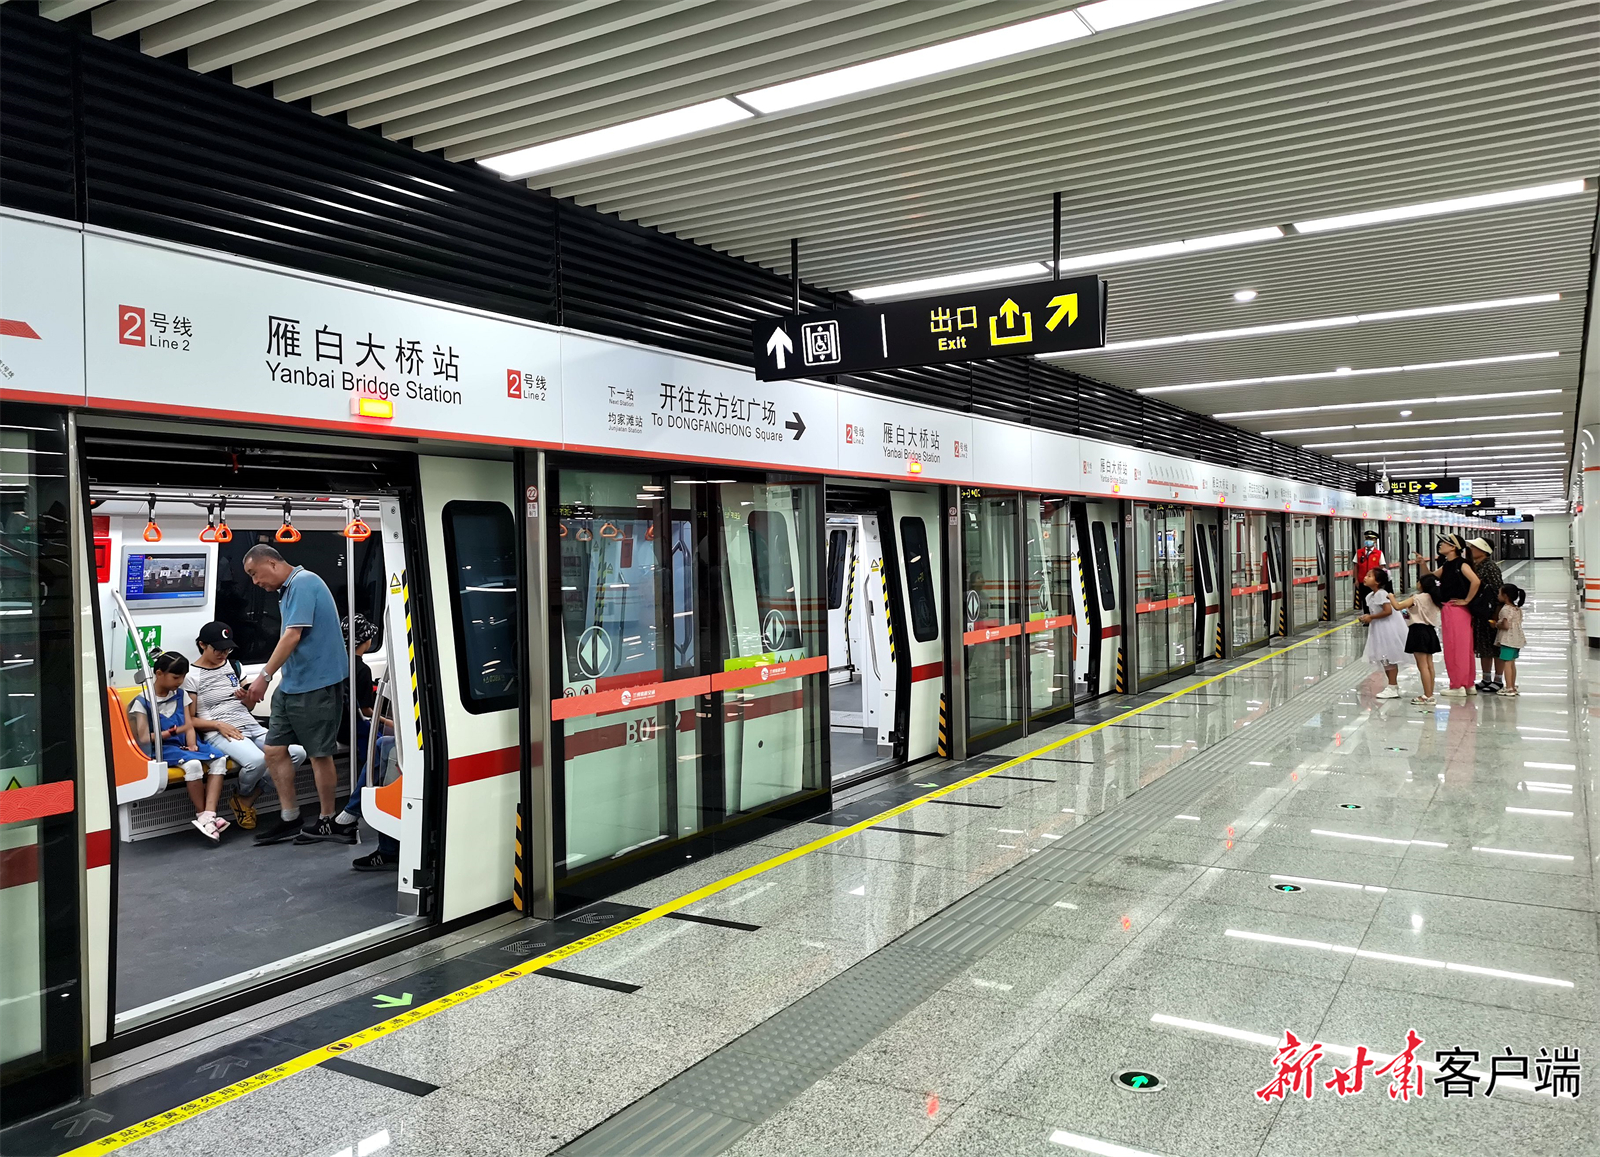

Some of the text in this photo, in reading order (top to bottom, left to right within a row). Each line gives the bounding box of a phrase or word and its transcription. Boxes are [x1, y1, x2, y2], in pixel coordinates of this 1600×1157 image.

[930, 305, 978, 333] 出口
[150, 335, 190, 351] Line 2
[266, 315, 460, 382] 雁白大桥站
[938, 336, 967, 352] Exit
[266, 360, 462, 405] Yanbai Bridge Station
[523, 389, 546, 401] Line 2
[608, 385, 634, 401] 下一站
[659, 383, 777, 426] 开往东方红广场
[651, 412, 784, 443] To DONGFANGHONG Square
[882, 422, 941, 451] 雁白大桥站
[882, 446, 903, 459] Yanbai
[923, 450, 941, 463] Station
[96, 1065, 288, 1147] 请站在黄线外排队候车
